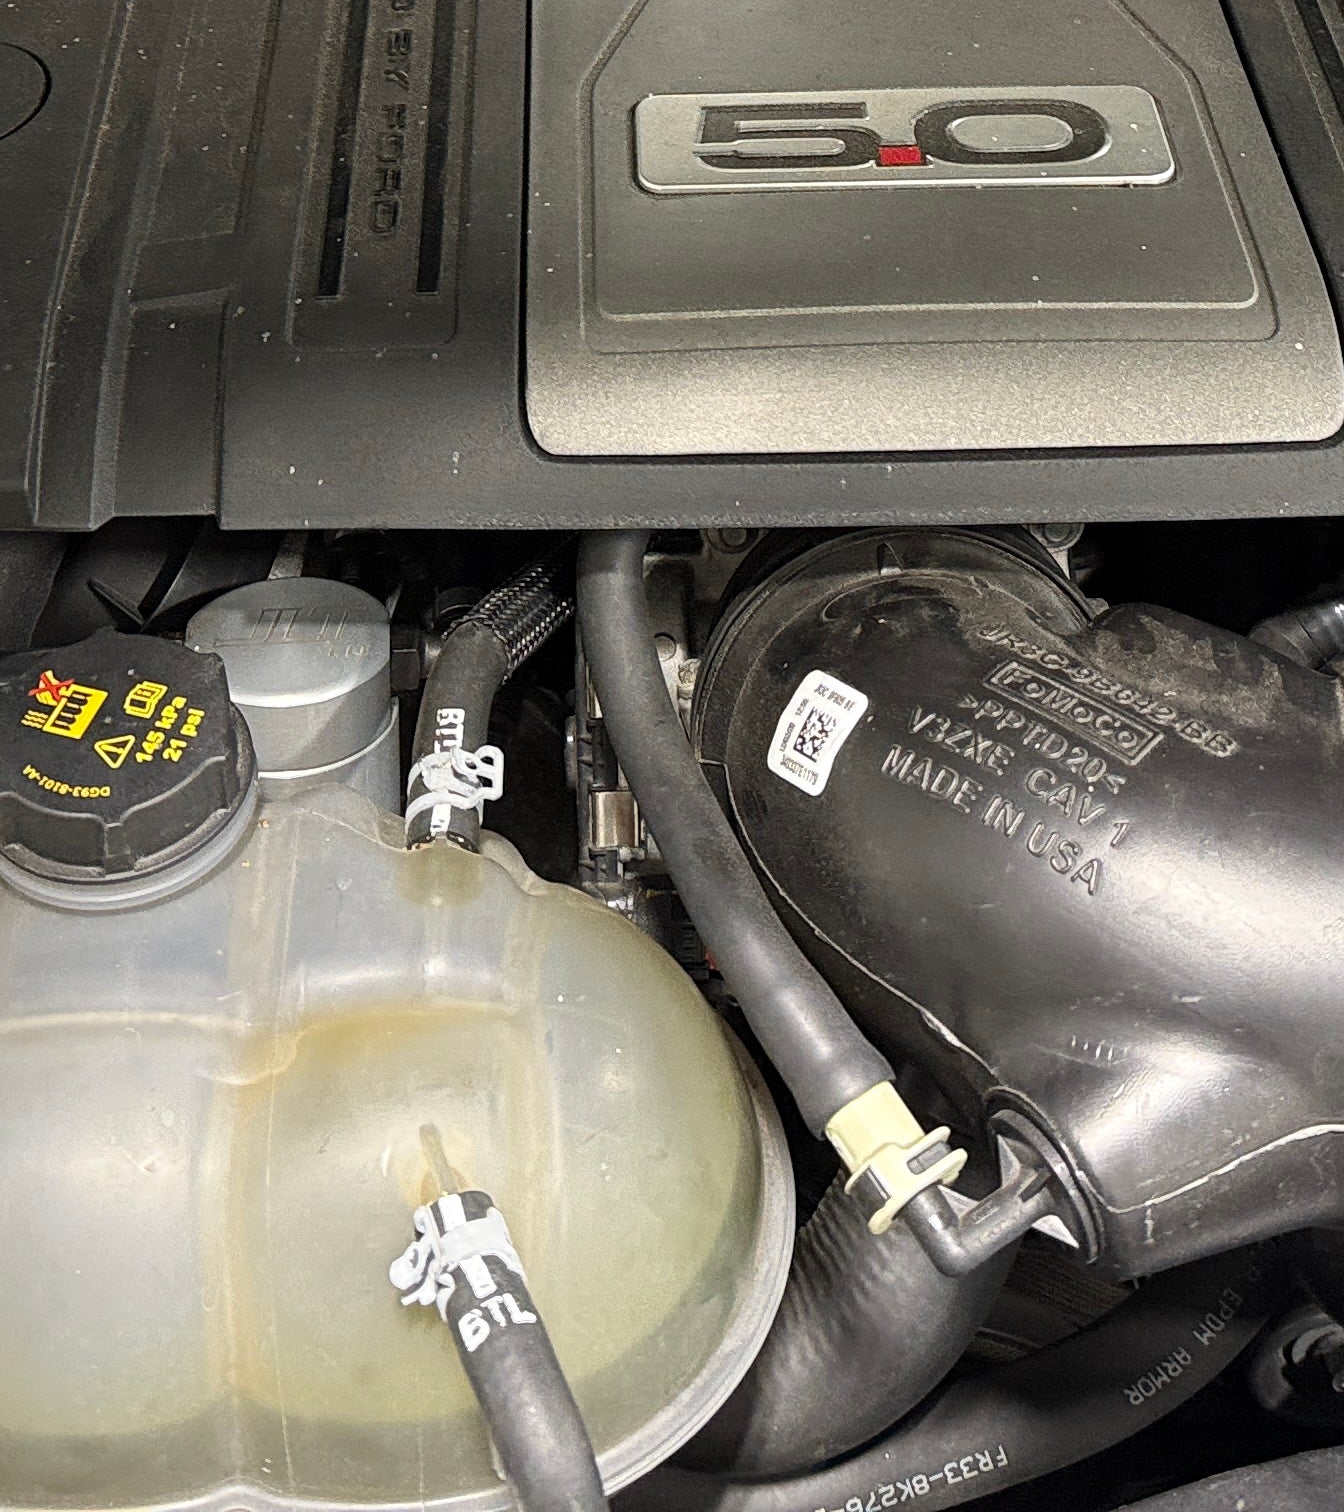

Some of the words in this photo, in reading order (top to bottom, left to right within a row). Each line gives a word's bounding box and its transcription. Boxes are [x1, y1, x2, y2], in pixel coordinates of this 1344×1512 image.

[383, 27, 413, 90] BY
[370, 102, 408, 234] FORD
[693, 100, 1113, 171] 5.0
[135, 730, 166, 763] 145
[154, 696, 188, 730] kPa
[162, 738, 188, 763] 21
[180, 708, 206, 738] psi
[999, 667, 1140, 751] FoMoCo
[881, 744, 984, 816] MADE
[981, 794, 1027, 839] IN
[1025, 820, 1105, 897] USA
[1024, 766, 1107, 826] CAV
[1192, 1288, 1244, 1348] EPDM
[1122, 1345, 1192, 1406] ARMOR
